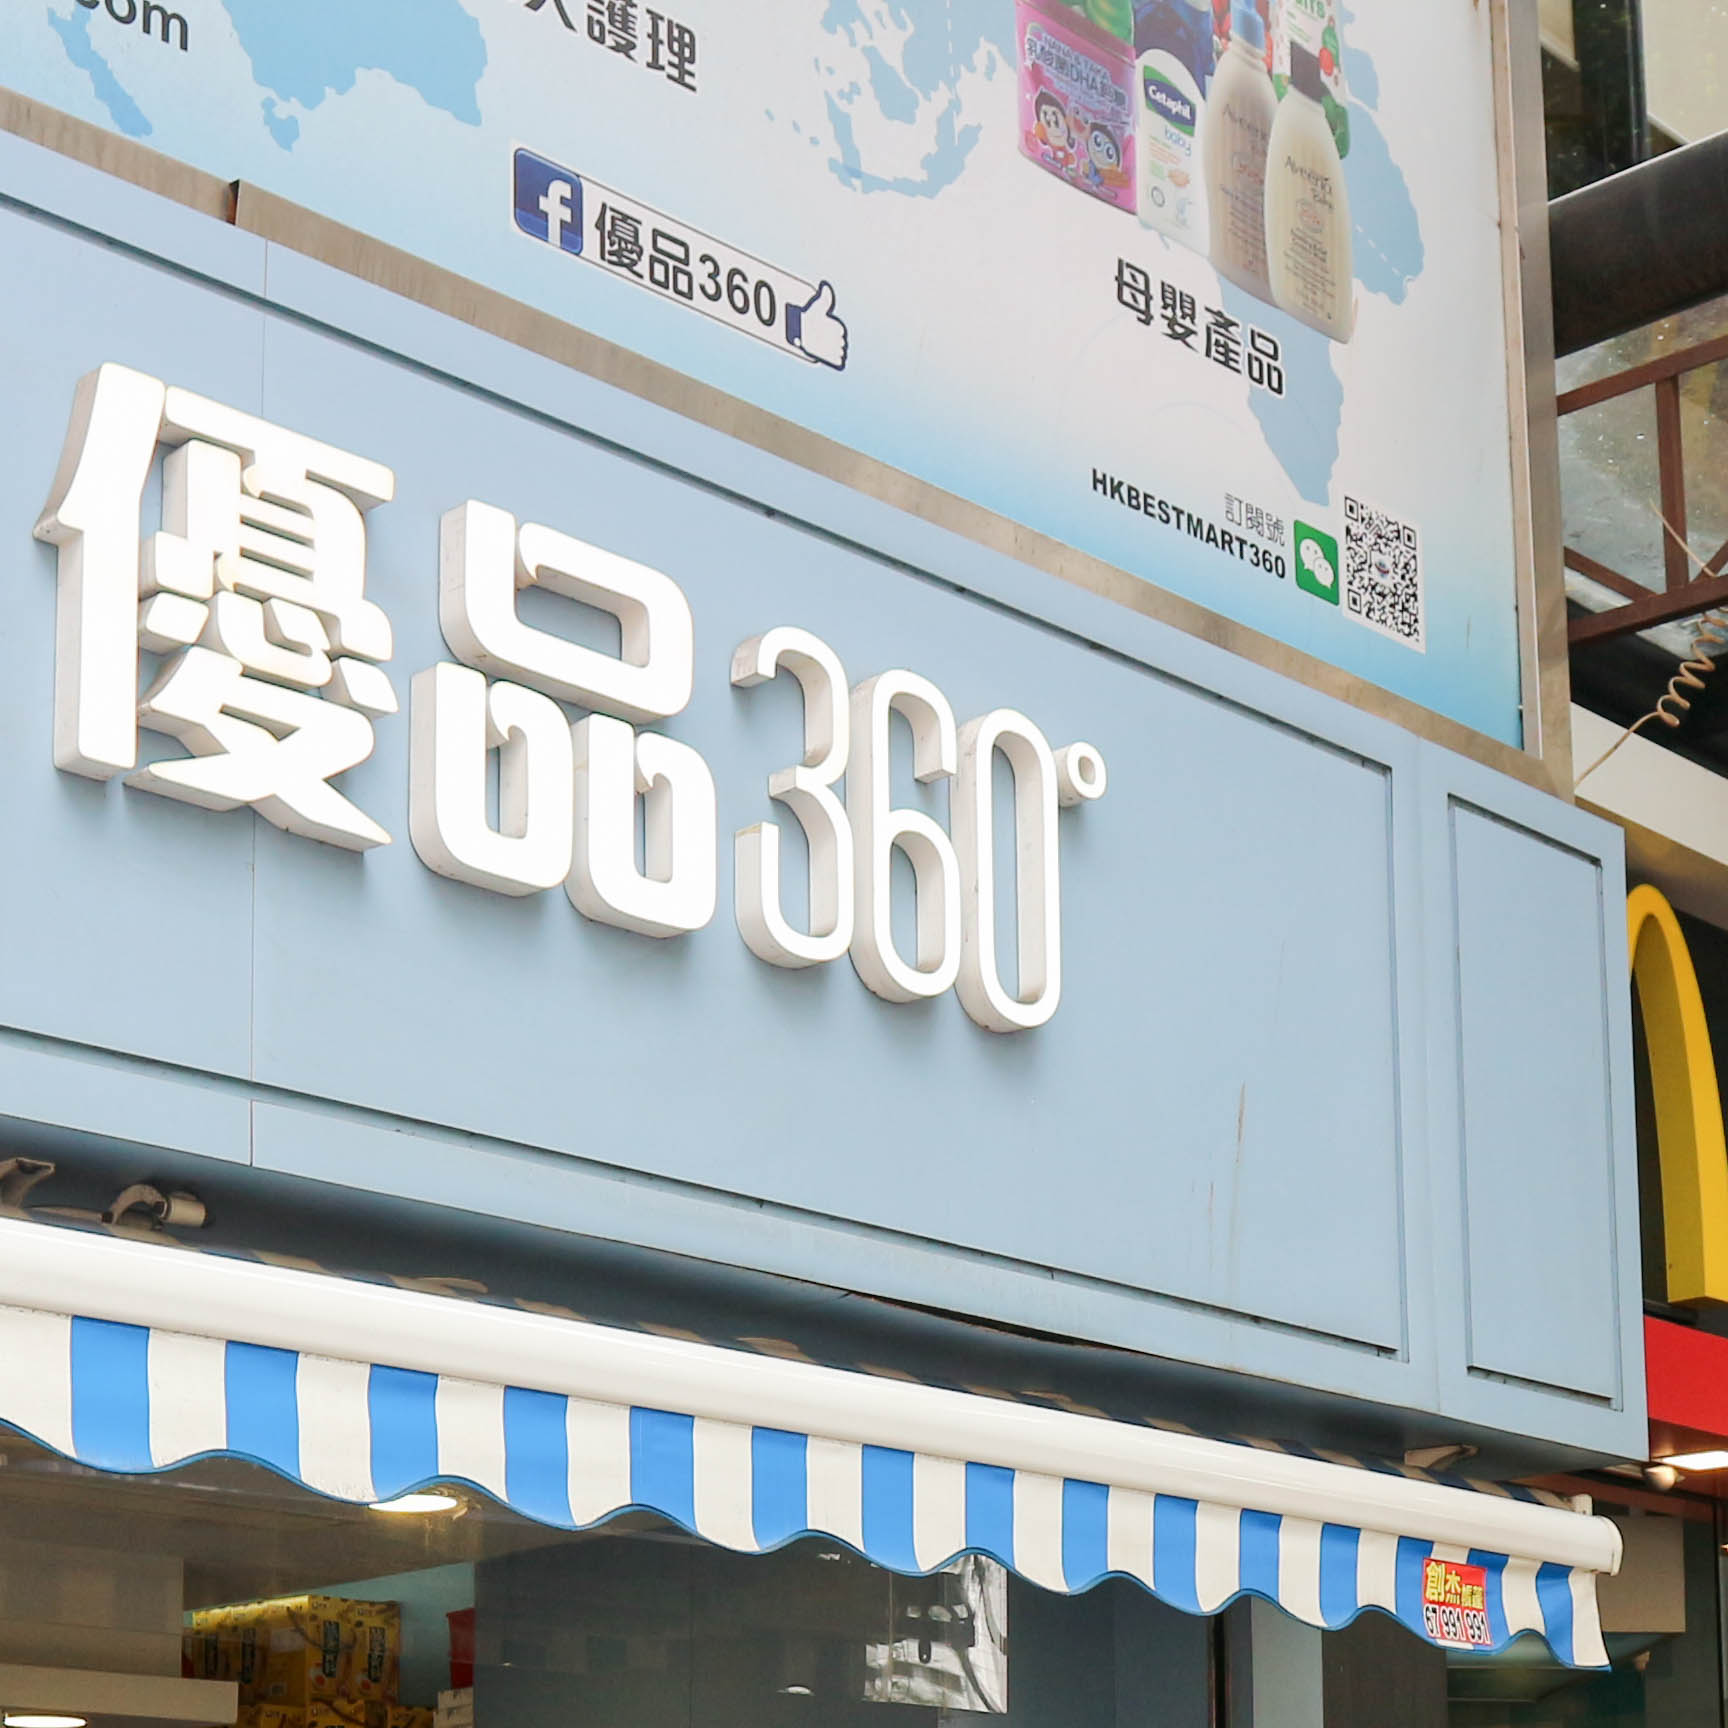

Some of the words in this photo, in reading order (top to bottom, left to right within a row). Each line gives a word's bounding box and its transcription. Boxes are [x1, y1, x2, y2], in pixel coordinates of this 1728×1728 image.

[87, 0, 189, 52] om
[1147, 83, 1193, 121] Cetaphil
[593, 200, 777, 329] 優品360
[1114, 256, 1285, 398] 母嬰產品
[1090, 466, 1288, 582] HKBESTMART360
[1223, 491, 1287, 550] 訂閱號
[1424, 1604, 1441, 1638] 67
[1440, 1606, 1466, 1641] 991
[1464, 1610, 1492, 1645] 991
